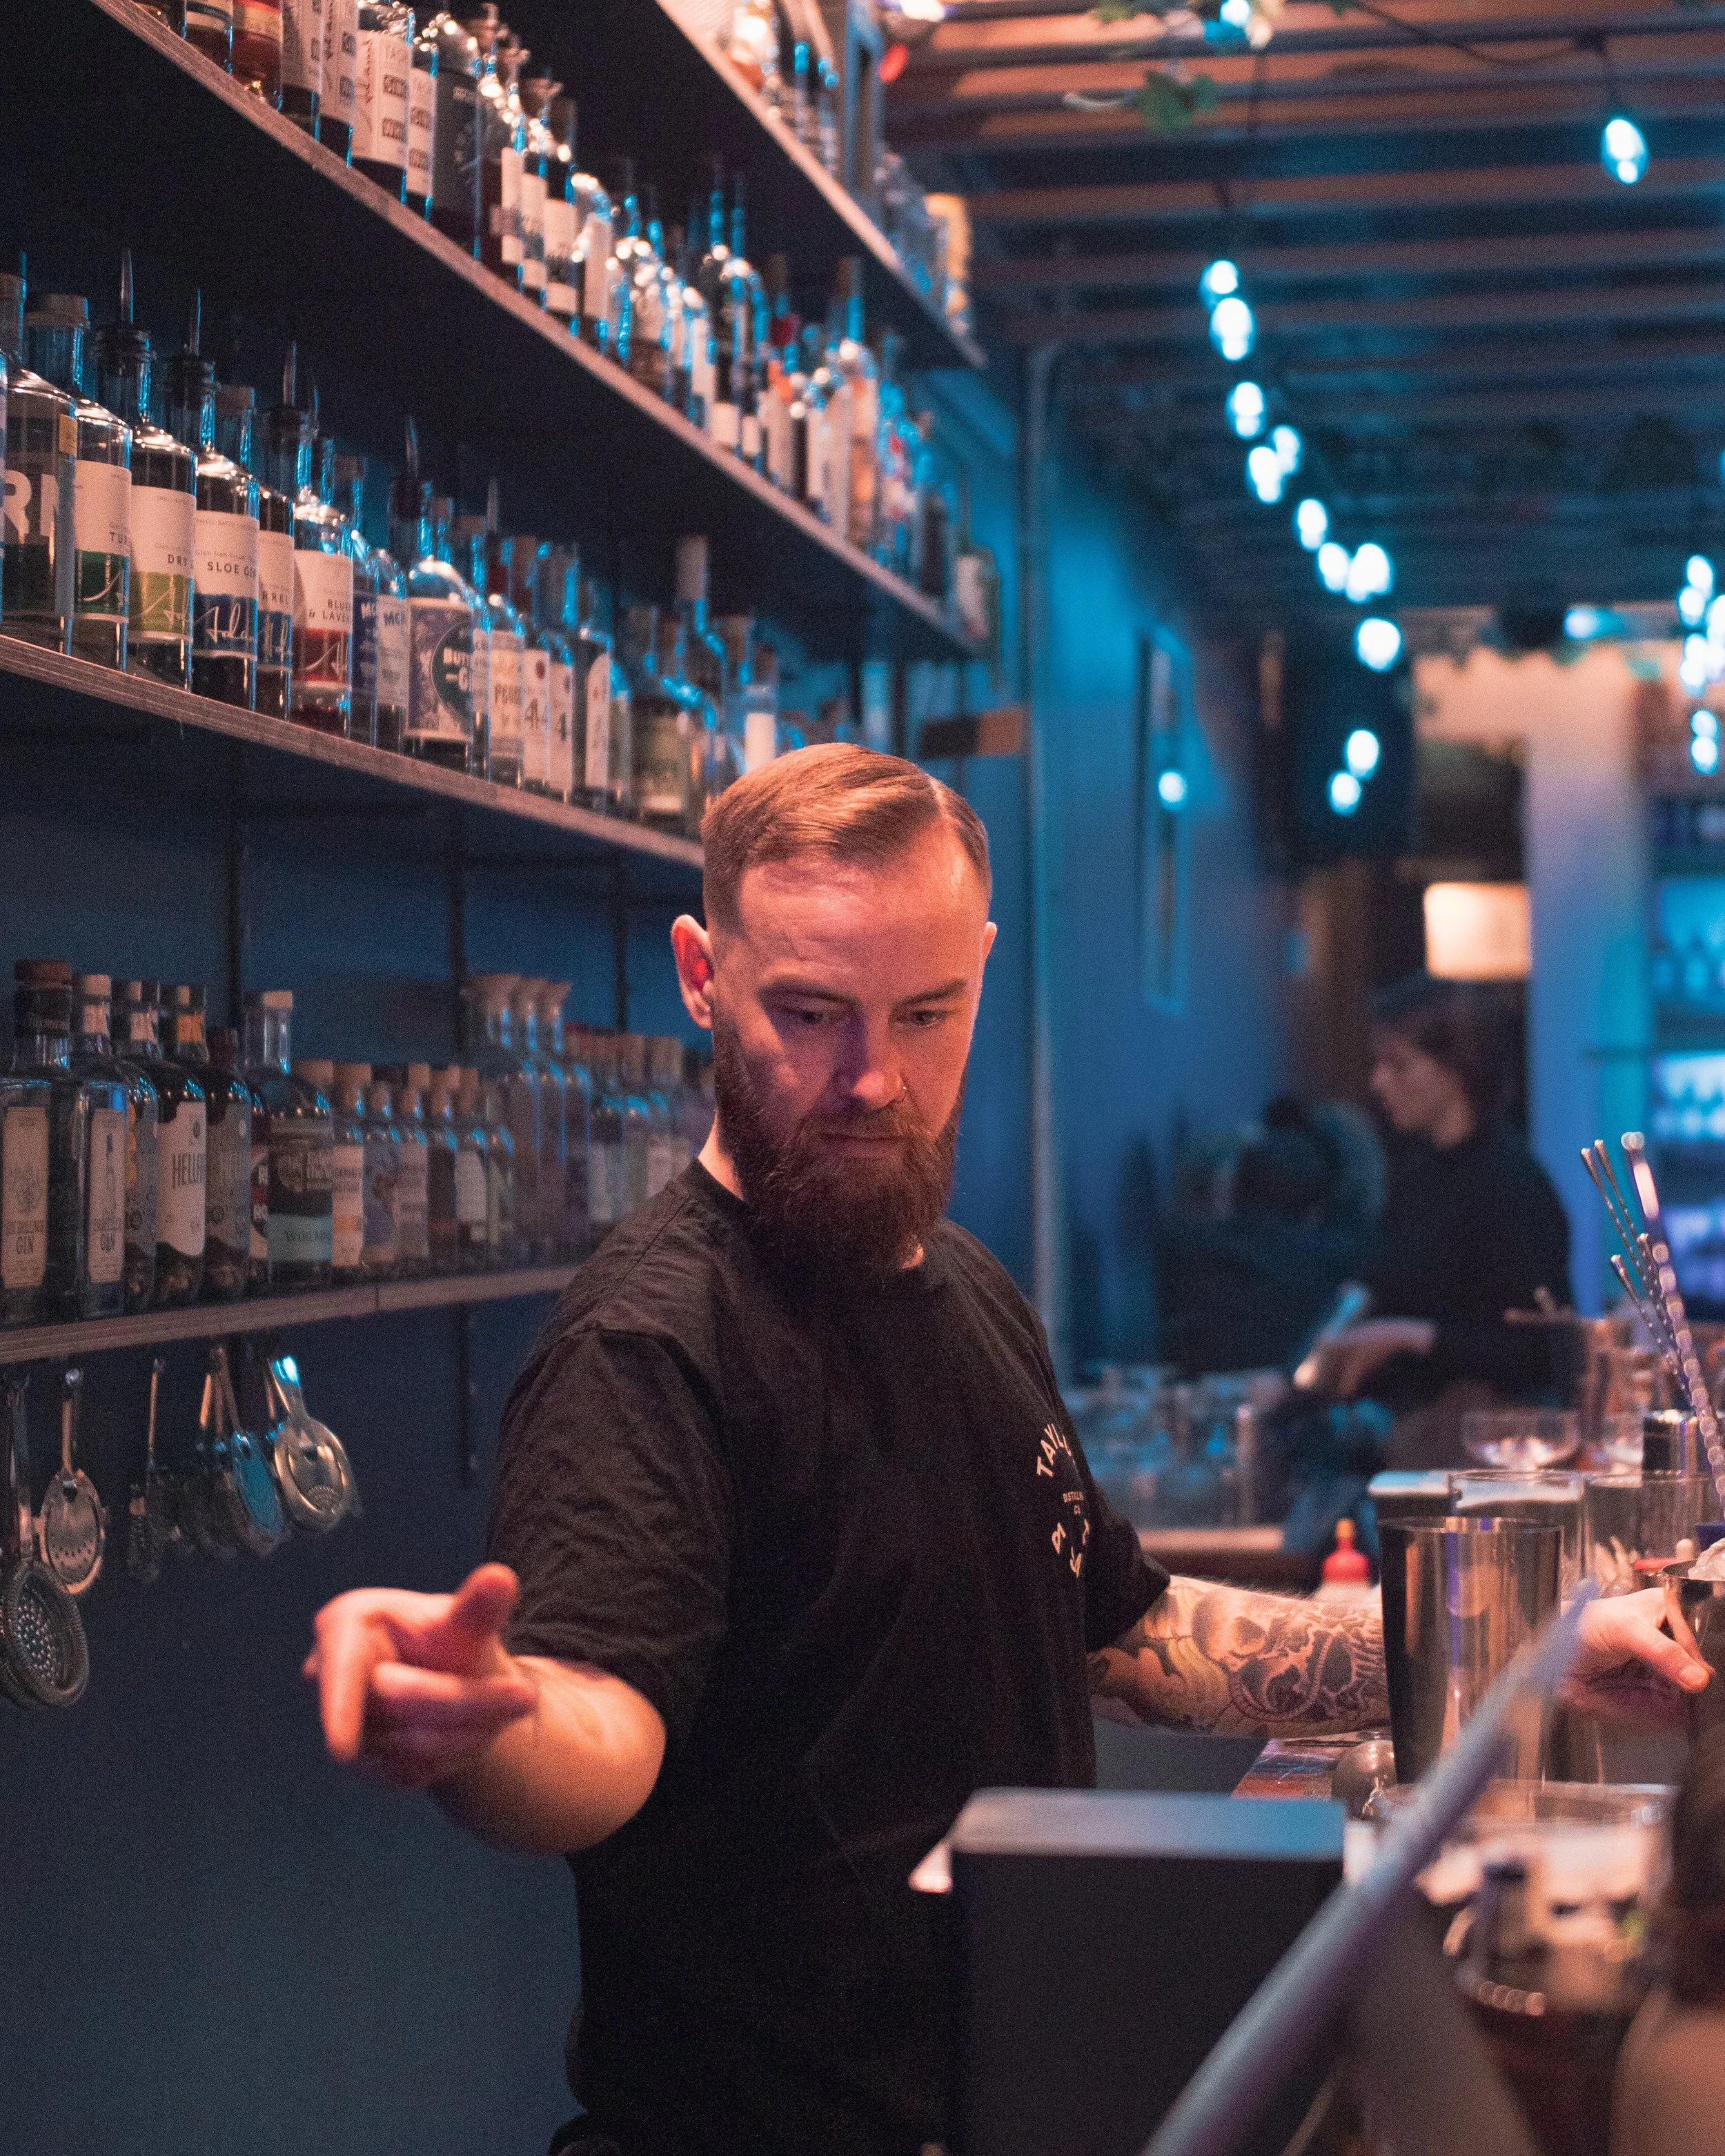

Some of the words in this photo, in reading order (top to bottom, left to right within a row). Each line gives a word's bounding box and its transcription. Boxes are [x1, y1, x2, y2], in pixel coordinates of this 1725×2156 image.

[168, 554, 188, 567] DRY
[207, 560, 240, 575] SLOE
[16, 1234, 34, 1255] GIN
